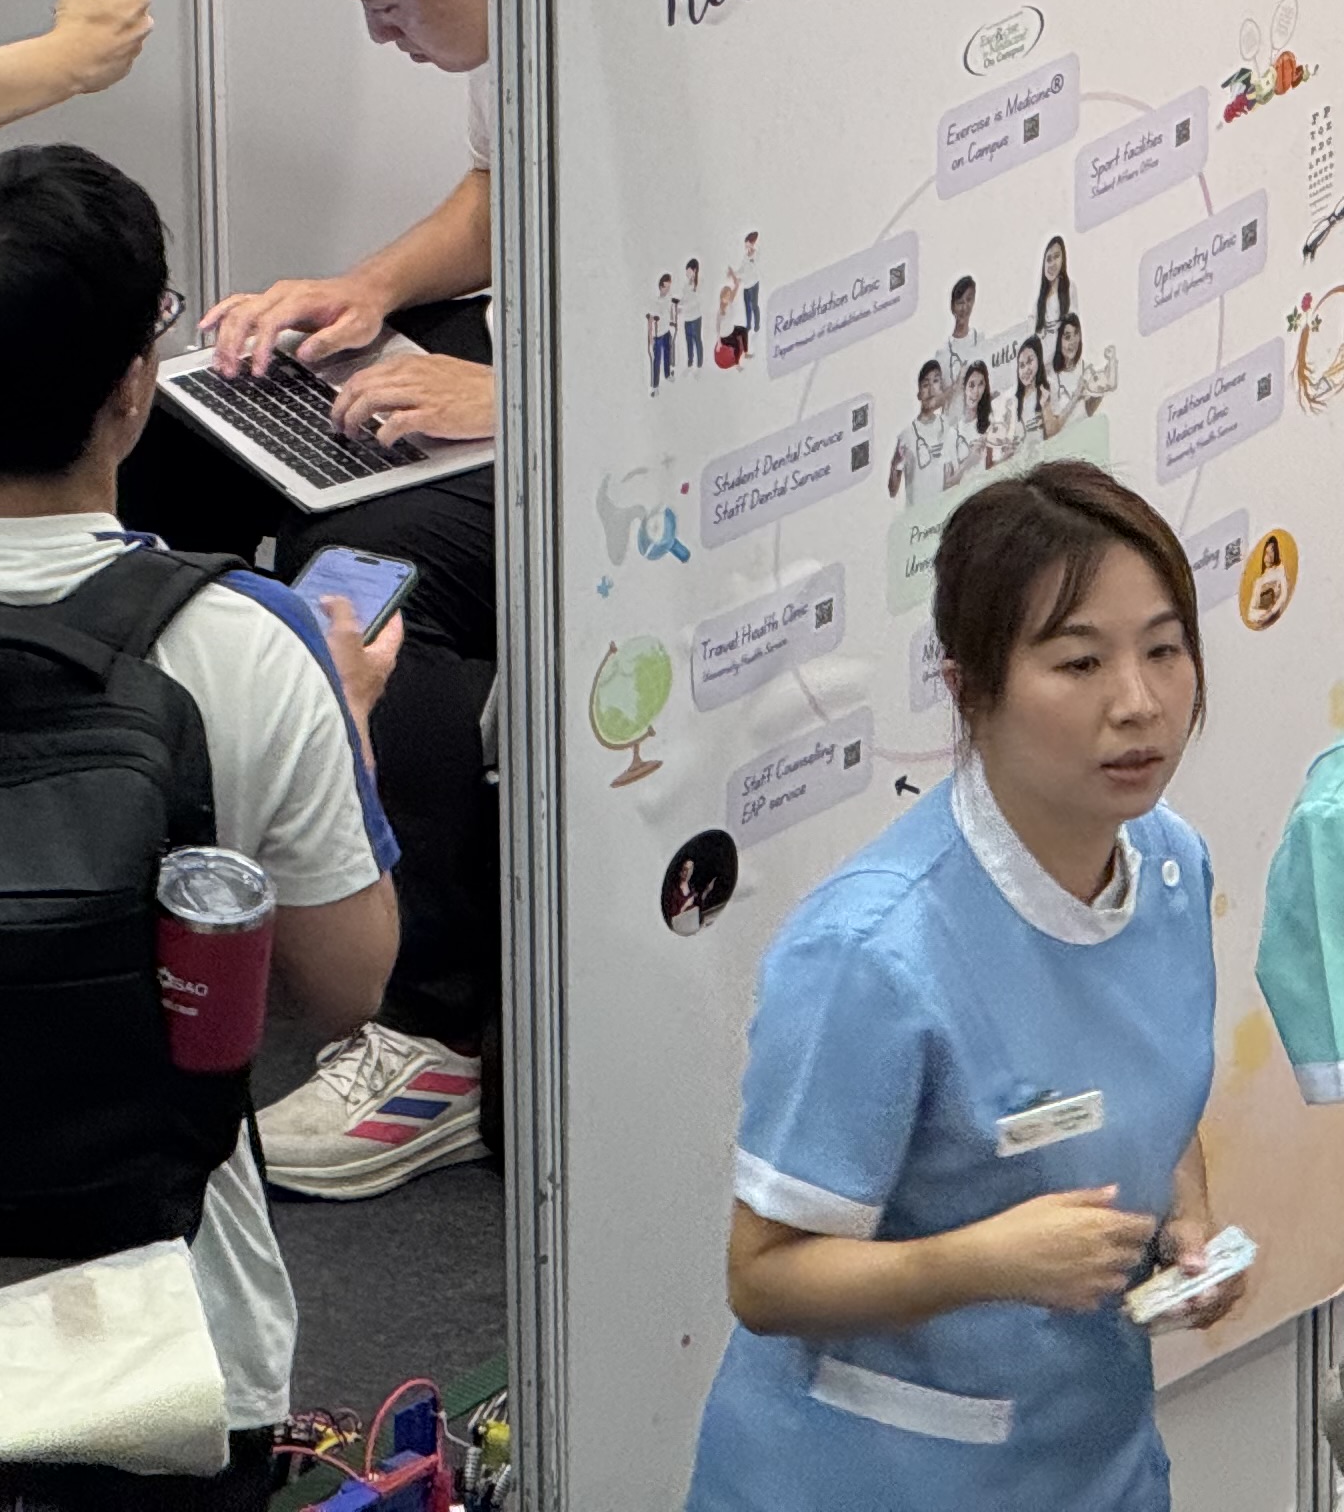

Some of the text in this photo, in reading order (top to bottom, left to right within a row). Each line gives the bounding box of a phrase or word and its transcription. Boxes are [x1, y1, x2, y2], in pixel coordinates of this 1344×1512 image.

[946, 116, 992, 145] Exercise
[967, 135, 1009, 163] Campus
[1090, 147, 1120, 188] Sport
[1154, 247, 1208, 293] Optometry
[774, 277, 880, 336] Rehabilitation Clinic
[713, 431, 843, 496] Student Dental Service
[713, 464, 831, 524] Staff Dental Service
[701, 631, 739, 660] Travel
